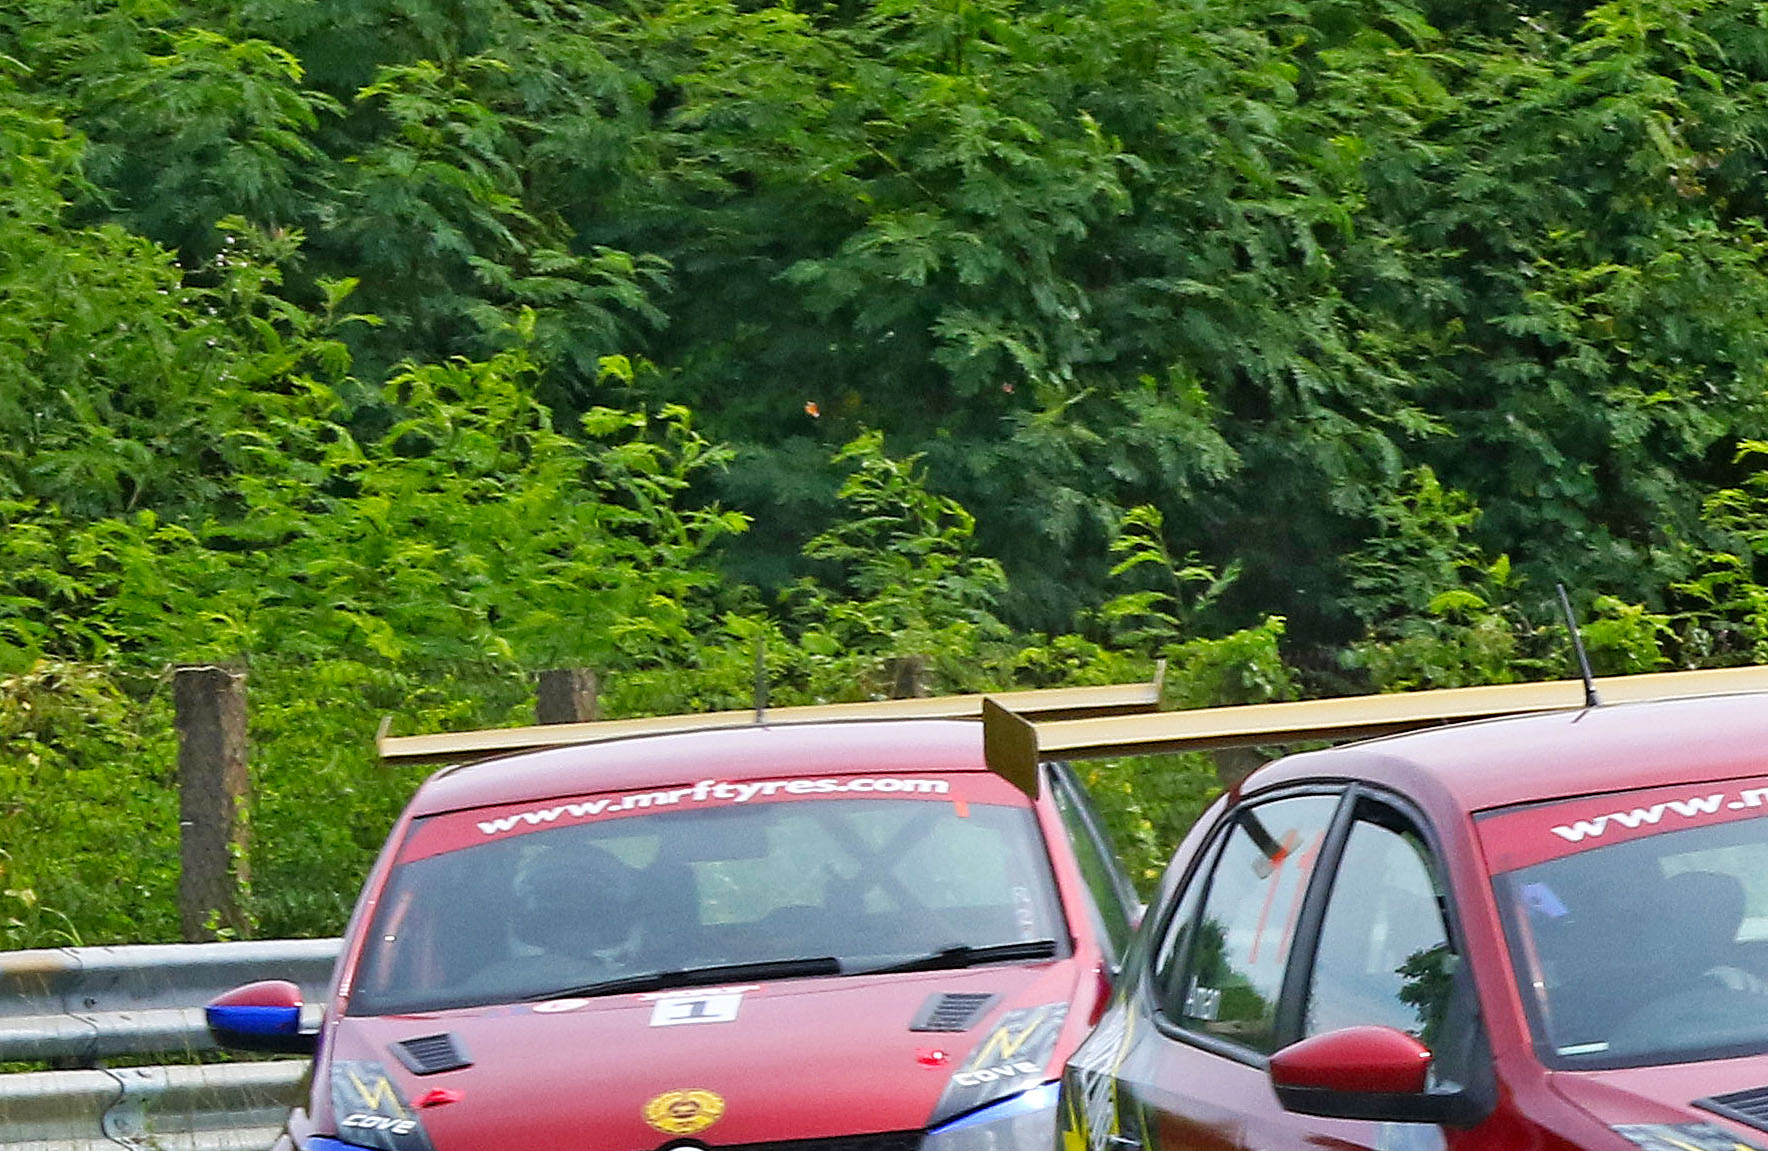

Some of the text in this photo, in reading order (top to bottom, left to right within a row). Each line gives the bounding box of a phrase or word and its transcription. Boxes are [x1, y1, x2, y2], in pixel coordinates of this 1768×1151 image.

[476, 776, 950, 835] www.mrftyres.com
[952, 1061, 1041, 1086] COVE
[341, 1113, 417, 1134] COVE
